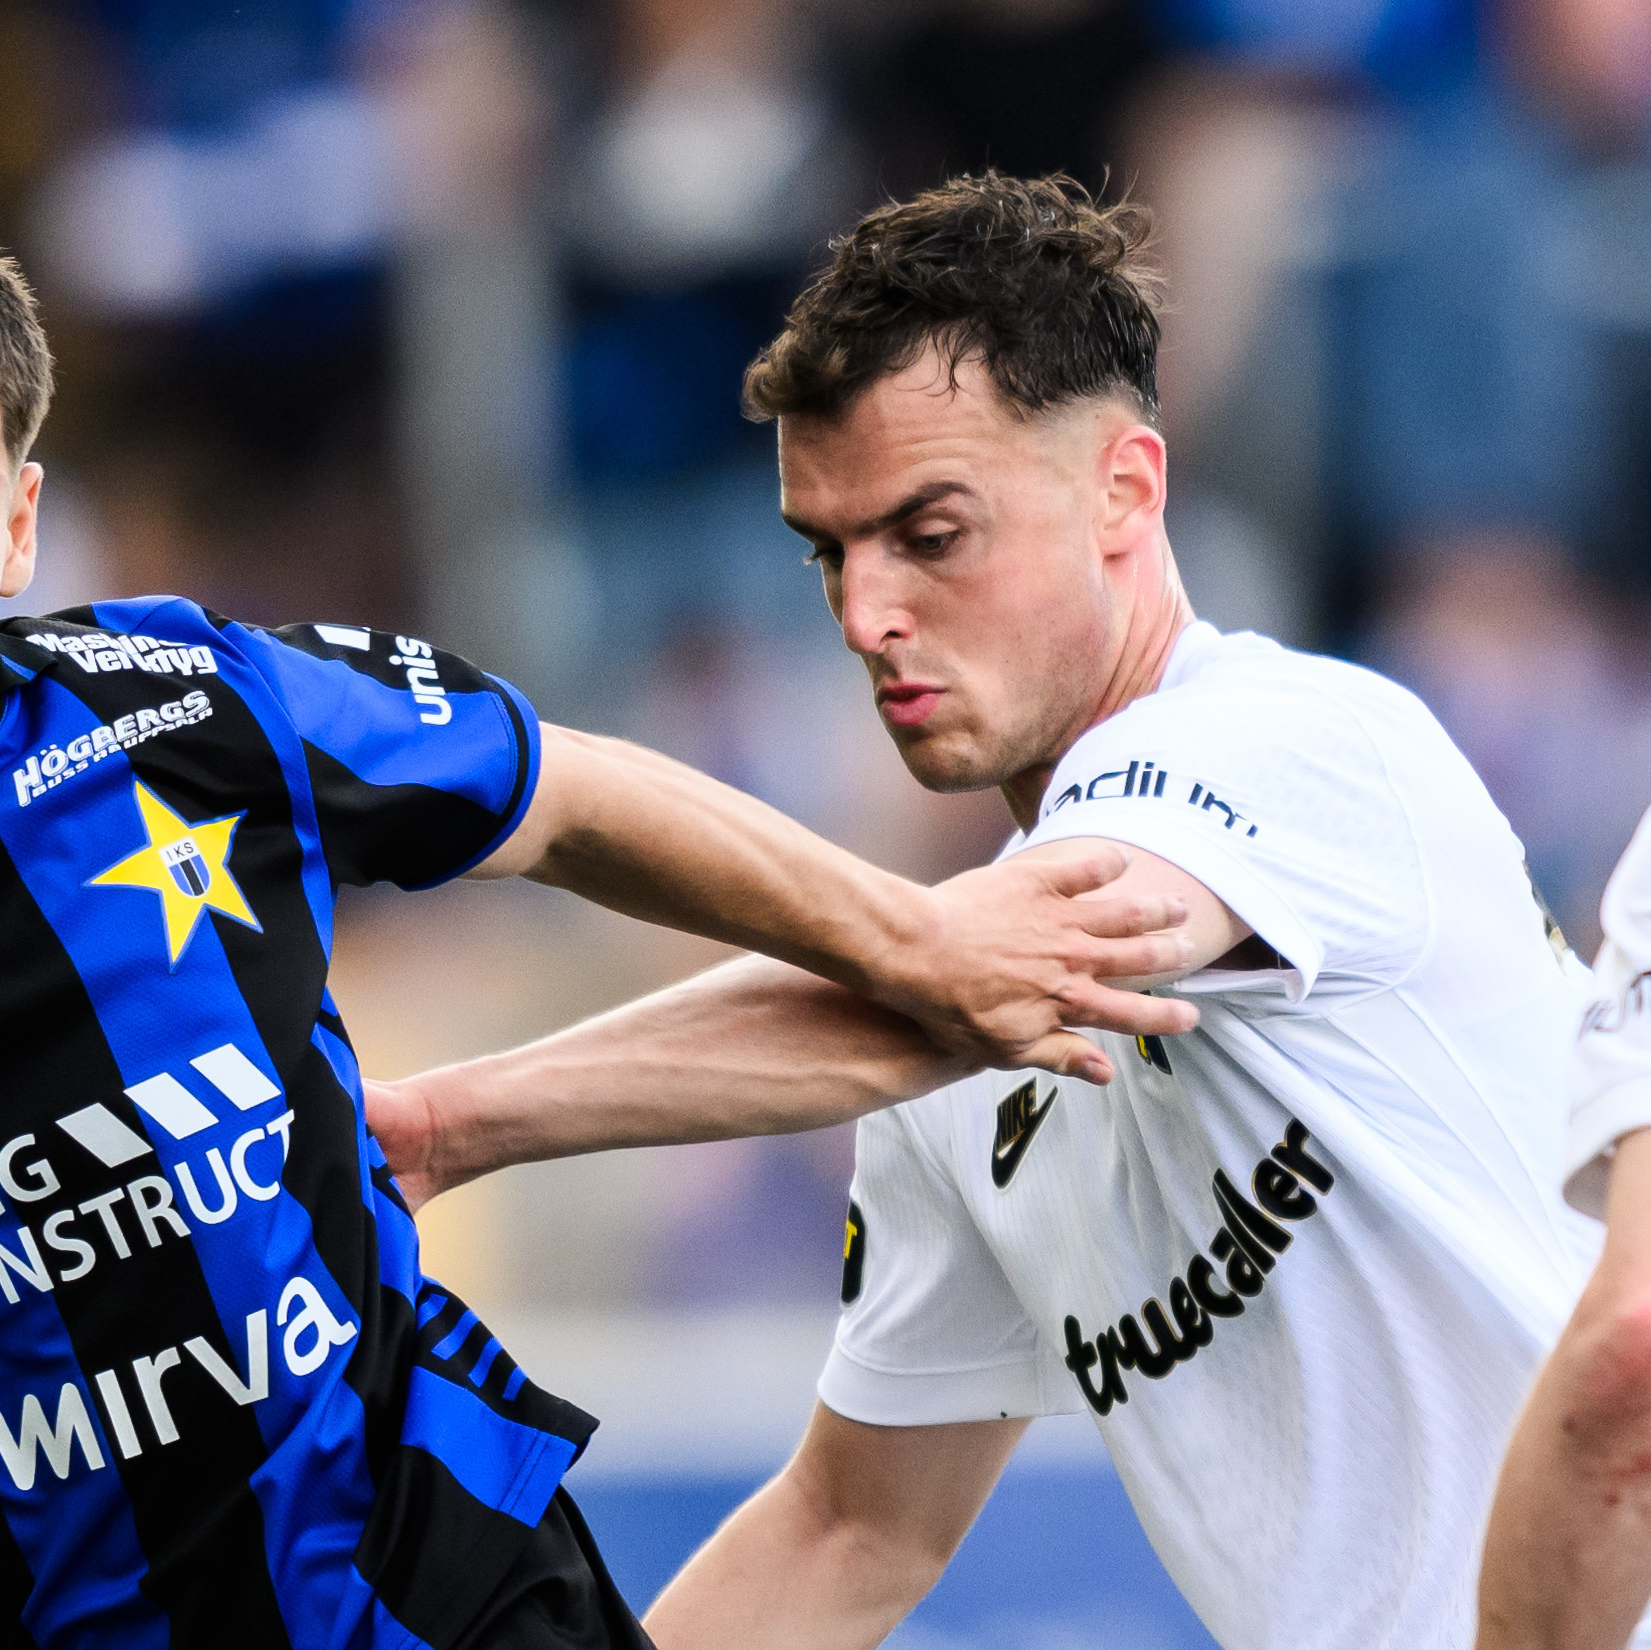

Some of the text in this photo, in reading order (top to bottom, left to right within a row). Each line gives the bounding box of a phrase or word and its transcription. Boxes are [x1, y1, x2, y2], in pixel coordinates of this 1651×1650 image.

[12, 690, 211, 807] HÖGBERGS
[32, 758, 90, 798] BUSS
[124, 707, 214, 749] UPPSALA
[166, 841, 195, 861] IKS
[1064, 1117, 1337, 1417] truecaller
